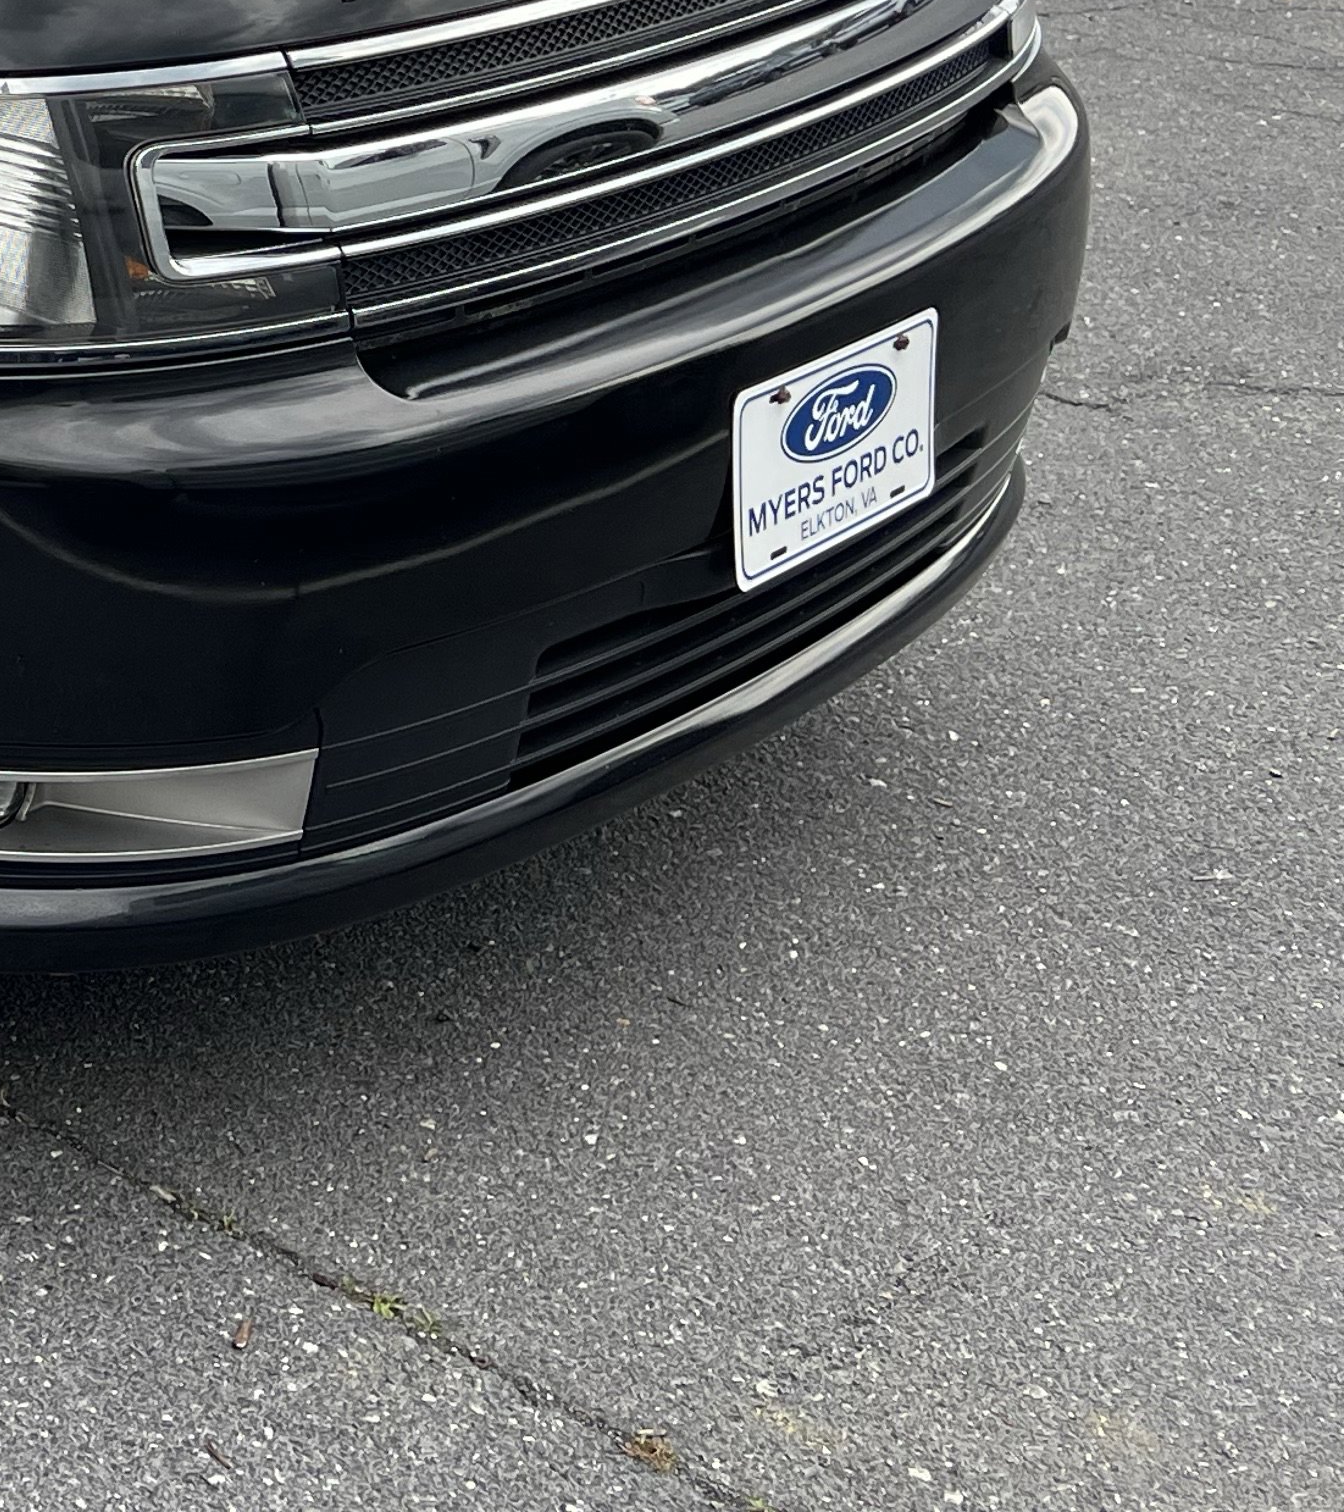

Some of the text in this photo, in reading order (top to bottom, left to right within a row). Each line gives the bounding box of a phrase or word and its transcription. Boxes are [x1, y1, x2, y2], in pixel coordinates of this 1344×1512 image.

[804, 380, 875, 451] Ford
[748, 428, 924, 537] MYERS FORD CO.
[800, 486, 878, 540] ELKTON, VA
